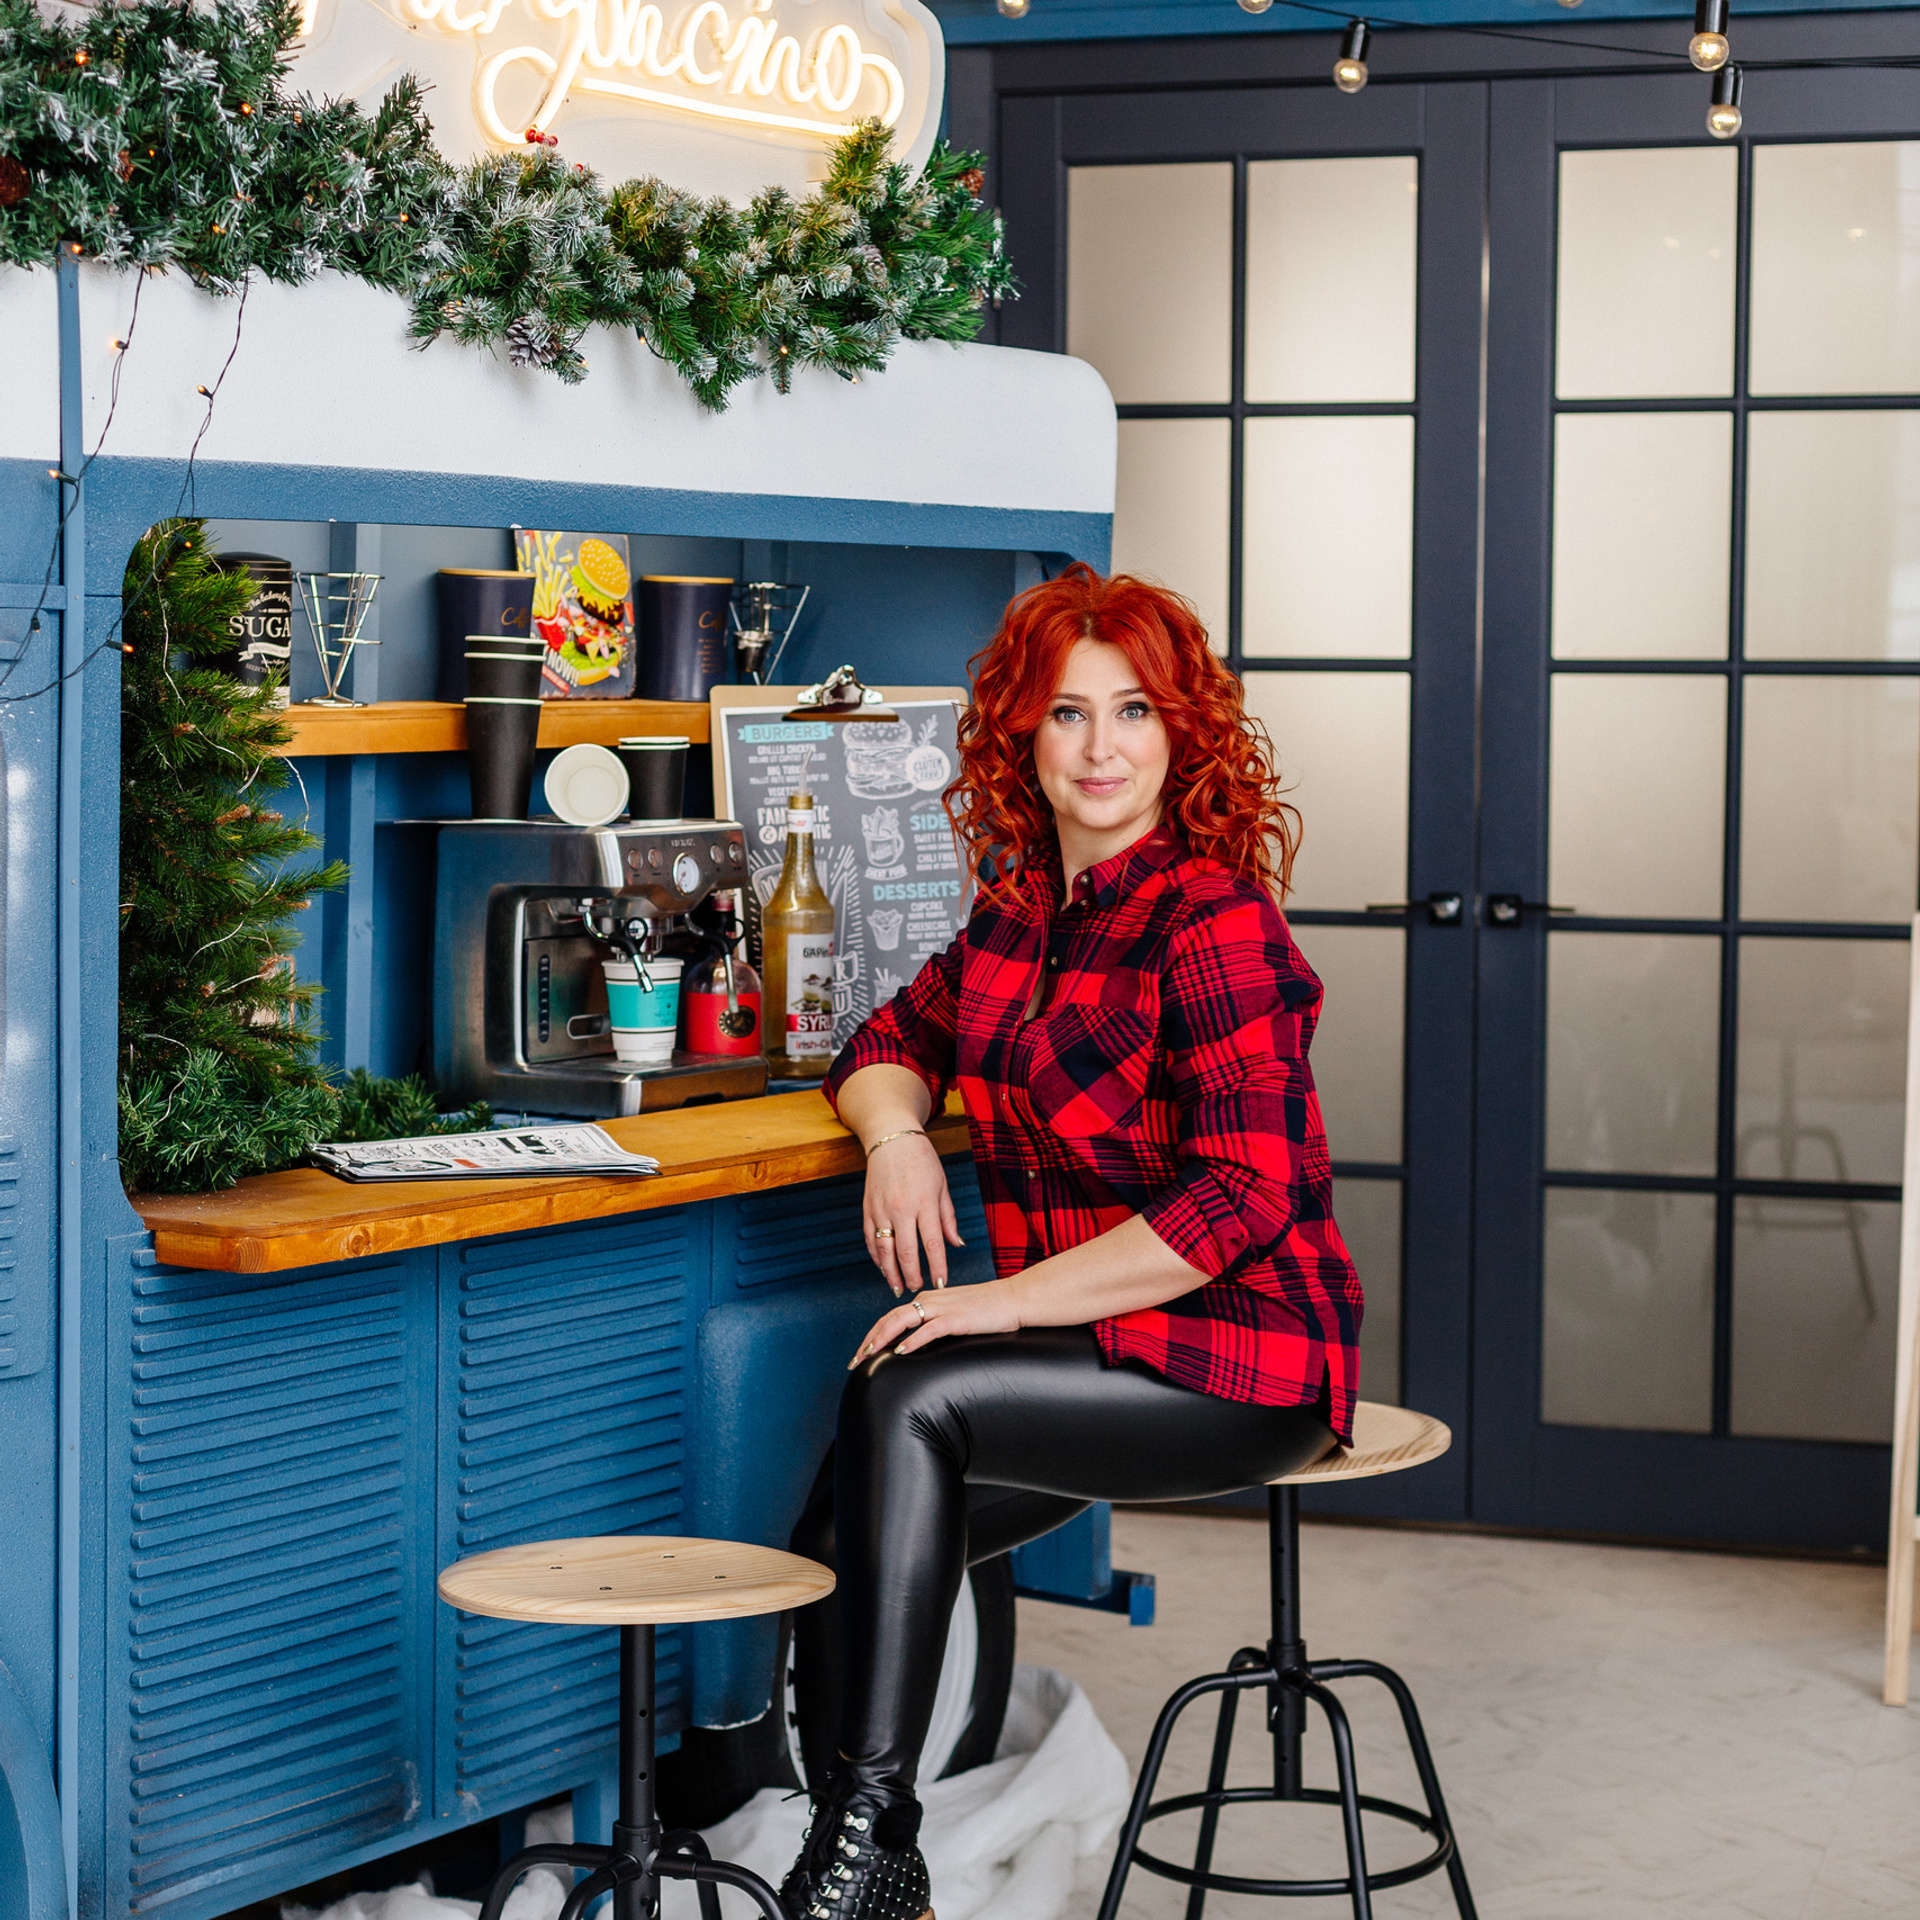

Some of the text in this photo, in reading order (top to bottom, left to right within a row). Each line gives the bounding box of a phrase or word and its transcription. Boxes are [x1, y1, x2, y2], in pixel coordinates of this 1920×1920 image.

[752, 725, 822, 740] BURGERS
[757, 805, 830, 826] FANTIC
[910, 813, 957, 831] SIDE
[873, 880, 961, 901] DESSERTS
